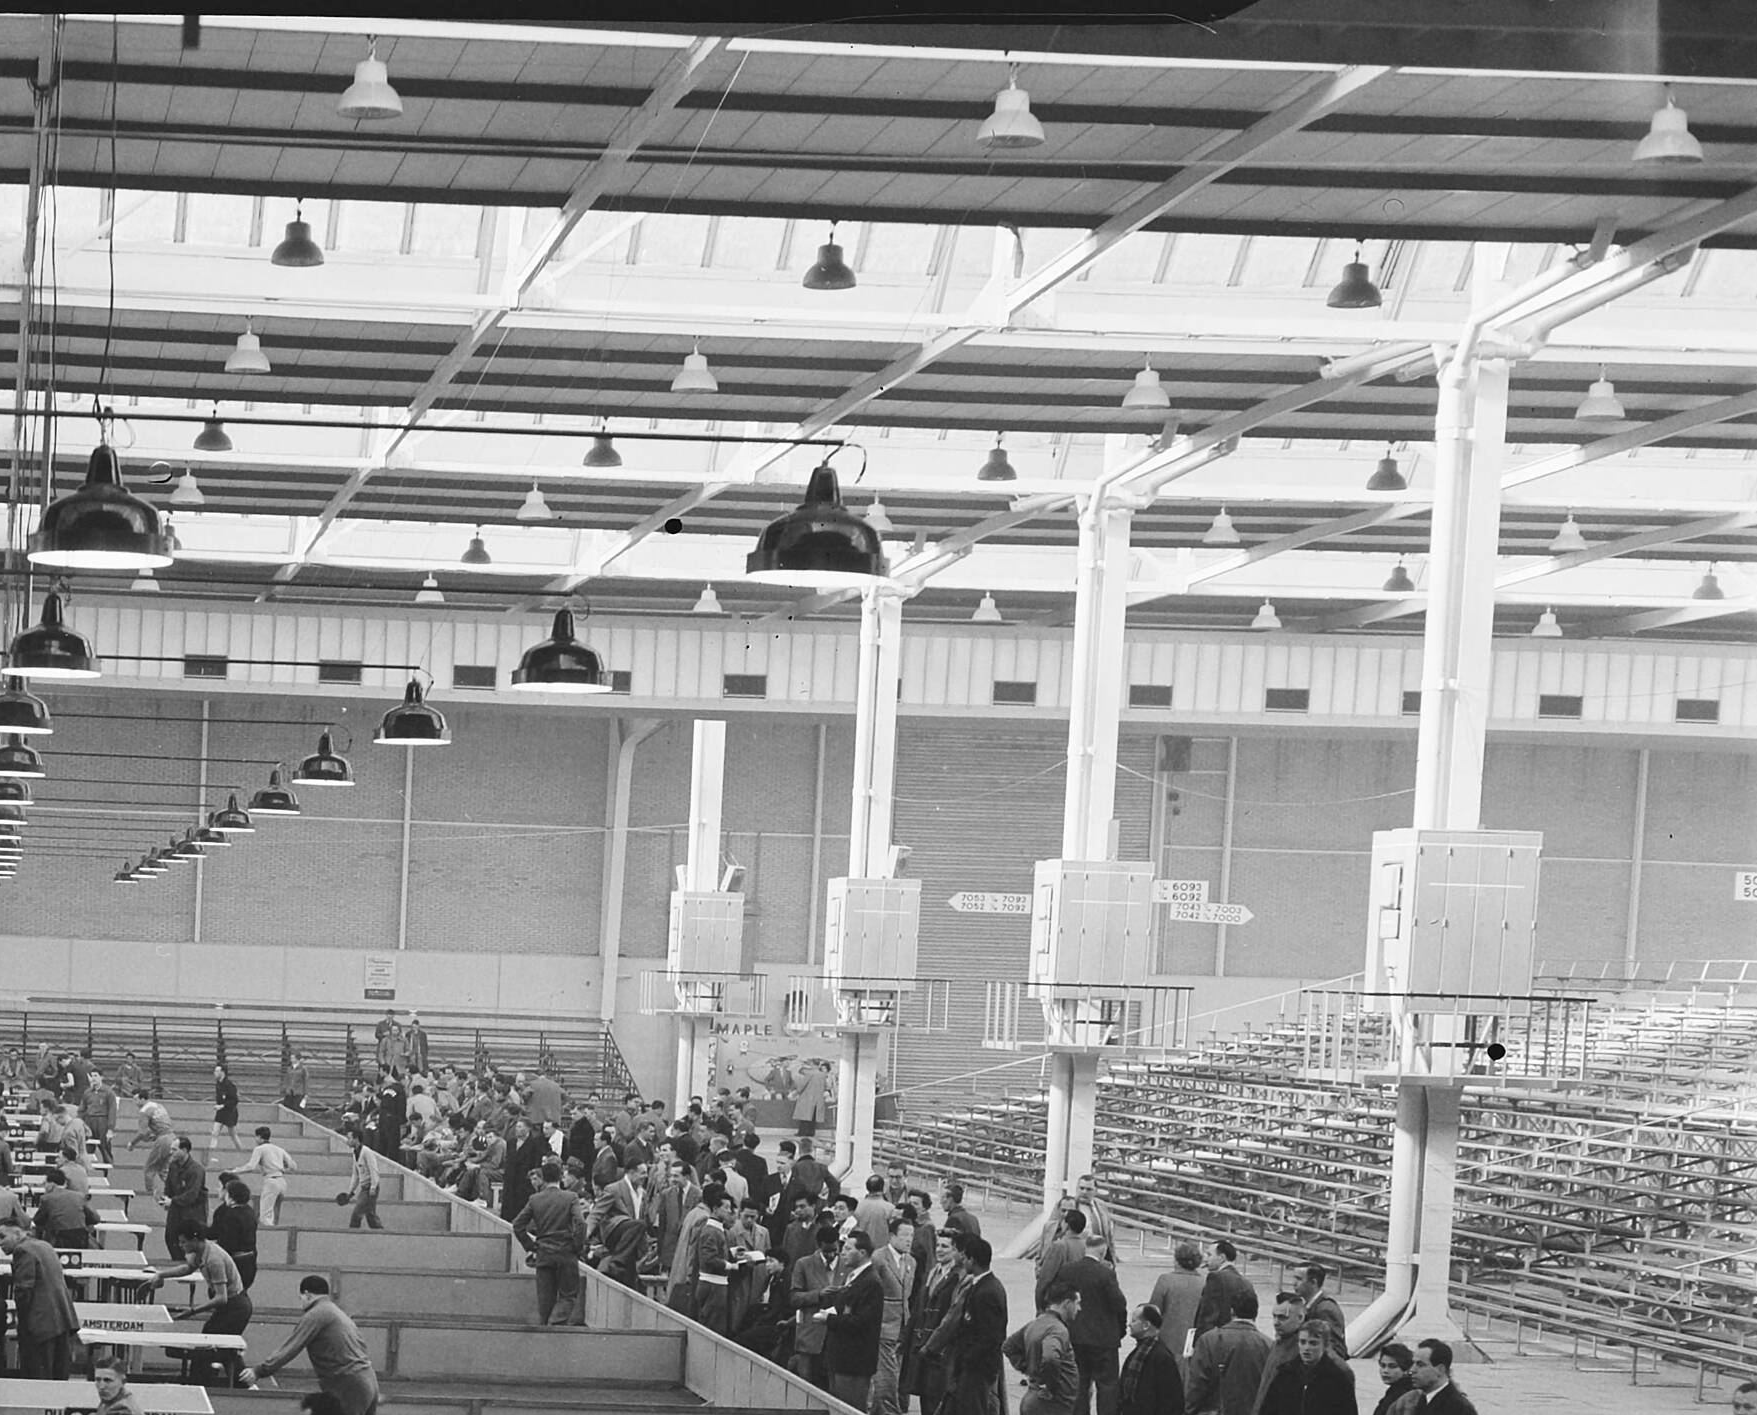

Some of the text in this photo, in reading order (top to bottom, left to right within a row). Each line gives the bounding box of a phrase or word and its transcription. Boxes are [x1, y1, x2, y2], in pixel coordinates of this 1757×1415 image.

[1172, 882, 1202, 892] 6093
[1172, 892, 1202, 902] 6092
[715, 1023, 772, 1036] MAPLE
[83, 1319, 144, 1330] AMSTERDAM
